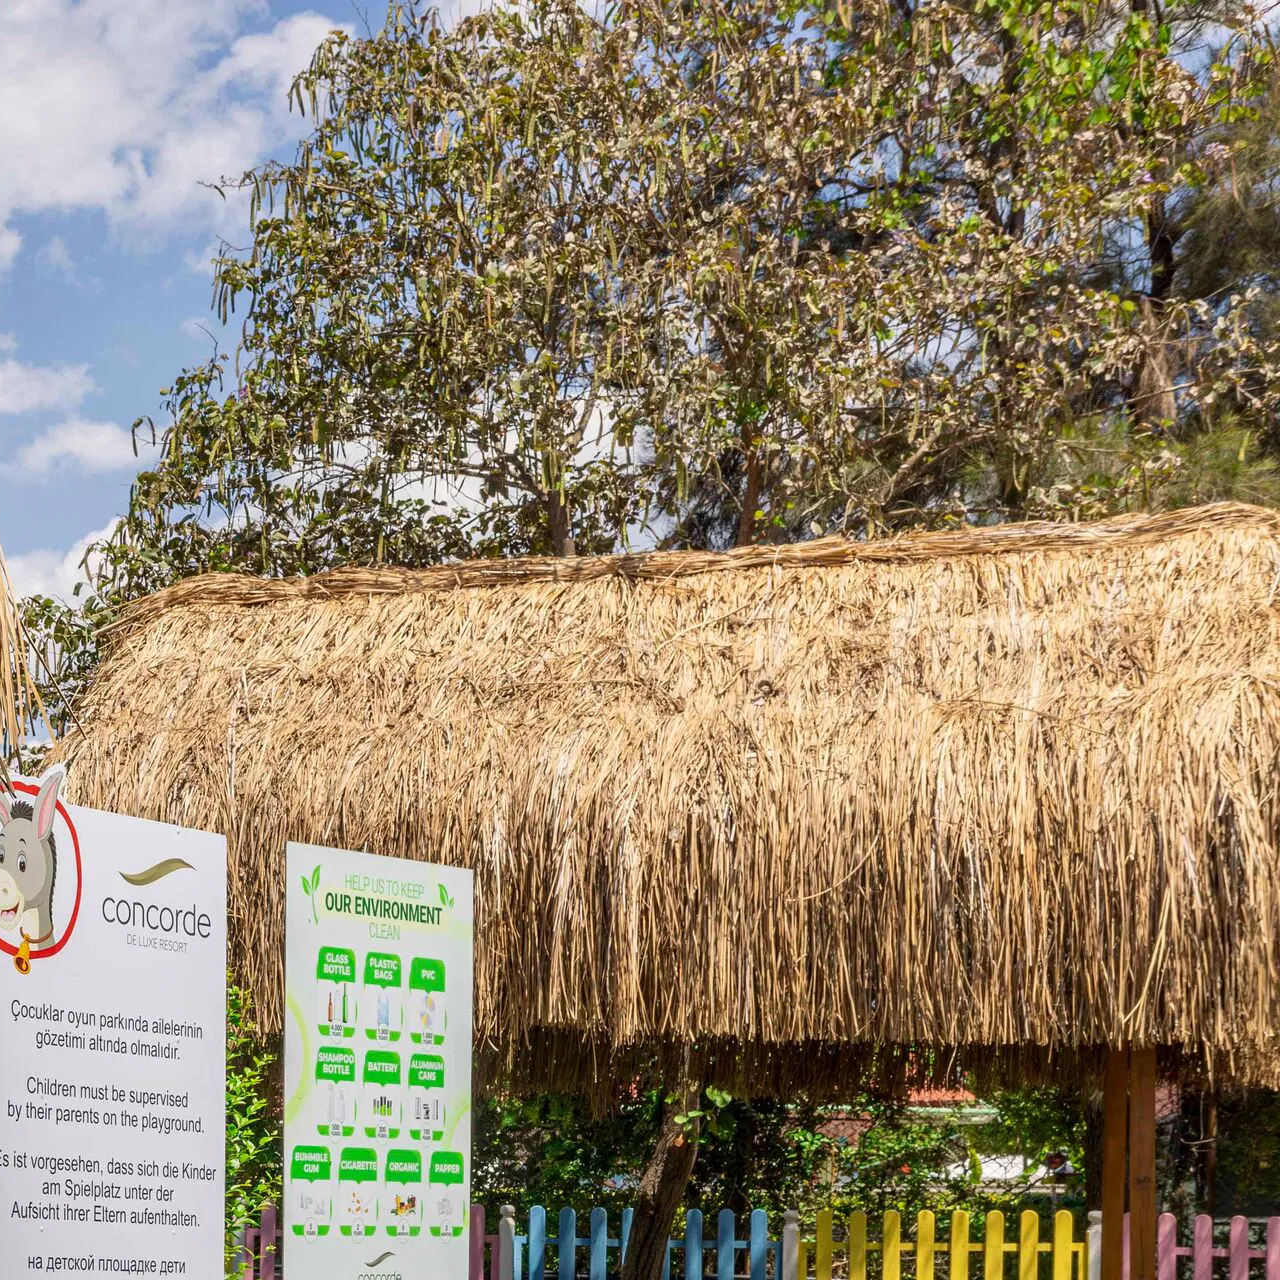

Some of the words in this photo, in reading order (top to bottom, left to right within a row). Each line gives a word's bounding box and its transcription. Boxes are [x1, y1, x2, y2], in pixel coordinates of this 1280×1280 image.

[344, 873, 370, 894] HELP
[372, 877, 385, 894] US
[386, 879, 399, 896] TO
[401, 881, 425, 899] KEEP
[325, 892, 352, 914] OUR
[355, 895, 442, 925] ENVIRONMENT
[102, 897, 211, 938] concorde
[369, 922, 400, 940] CLEAN
[127, 934, 136, 945] DE
[139, 936, 157, 948] LUXE
[160, 939, 188, 953] RESORT
[326, 953, 349, 964] GLASS
[370, 958, 397, 969] PLASTIC
[324, 964, 351, 975] BOTTLE
[374, 970, 393, 980] BAGS
[421, 969, 435, 980] PVC
[11, 999, 64, 1022] Çocuklar
[68, 1011, 96, 1030] oyun
[99, 1012, 148, 1033] parkında
[152, 1017, 203, 1040] ailelerinin
[36, 1030, 86, 1049] gözetimi
[89, 1033, 127, 1054] altında
[130, 1037, 180, 1060] olmalıdır.
[319, 1052, 354, 1064] SHAMPOO
[323, 1064, 350, 1075] BOTTLE
[368, 1062, 398, 1072] BATTERY
[418, 1071, 436, 1080] CANS
[26, 1076, 76, 1097] Children
[80, 1082, 108, 1101] must
[112, 1085, 126, 1102] be
[129, 1088, 188, 1108] supervised
[8, 1101, 22, 1122] by
[26, 1102, 52, 1120] their
[56, 1106, 100, 1125] parents
[103, 1112, 117, 1126] on
[120, 1110, 138, 1128] the
[141, 1112, 204, 1135] playground.
[13, 1151, 27, 1169] ist
[30, 1156, 104, 1176] vorgesehen,
[106, 1158, 134, 1176] dass
[137, 1159, 159, 1177] sich
[162, 1161, 179, 1178] die
[182, 1159, 216, 1180] Kinder
[304, 1163, 319, 1173] GUM
[341, 1160, 376, 1170] CIGARETTE
[389, 1162, 419, 1172] ORGANIC
[435, 1164, 460, 1173] PAPPER
[42, 1182, 61, 1196] am
[64, 1179, 121, 1202] Spielplatz
[124, 1184, 153, 1200] unter
[156, 1183, 174, 1201] der
[11, 1201, 60, 1221] Aufsicht
[63, 1203, 90, 1222] ihrer
[93, 1205, 126, 1224] Eltern
[130, 1206, 200, 1227] aufenthalten.
[28, 1256, 43, 1269] на
[46, 1254, 94, 1271] детской
[98, 1258, 156, 1275] площадке
[160, 1259, 186, 1274] дети
